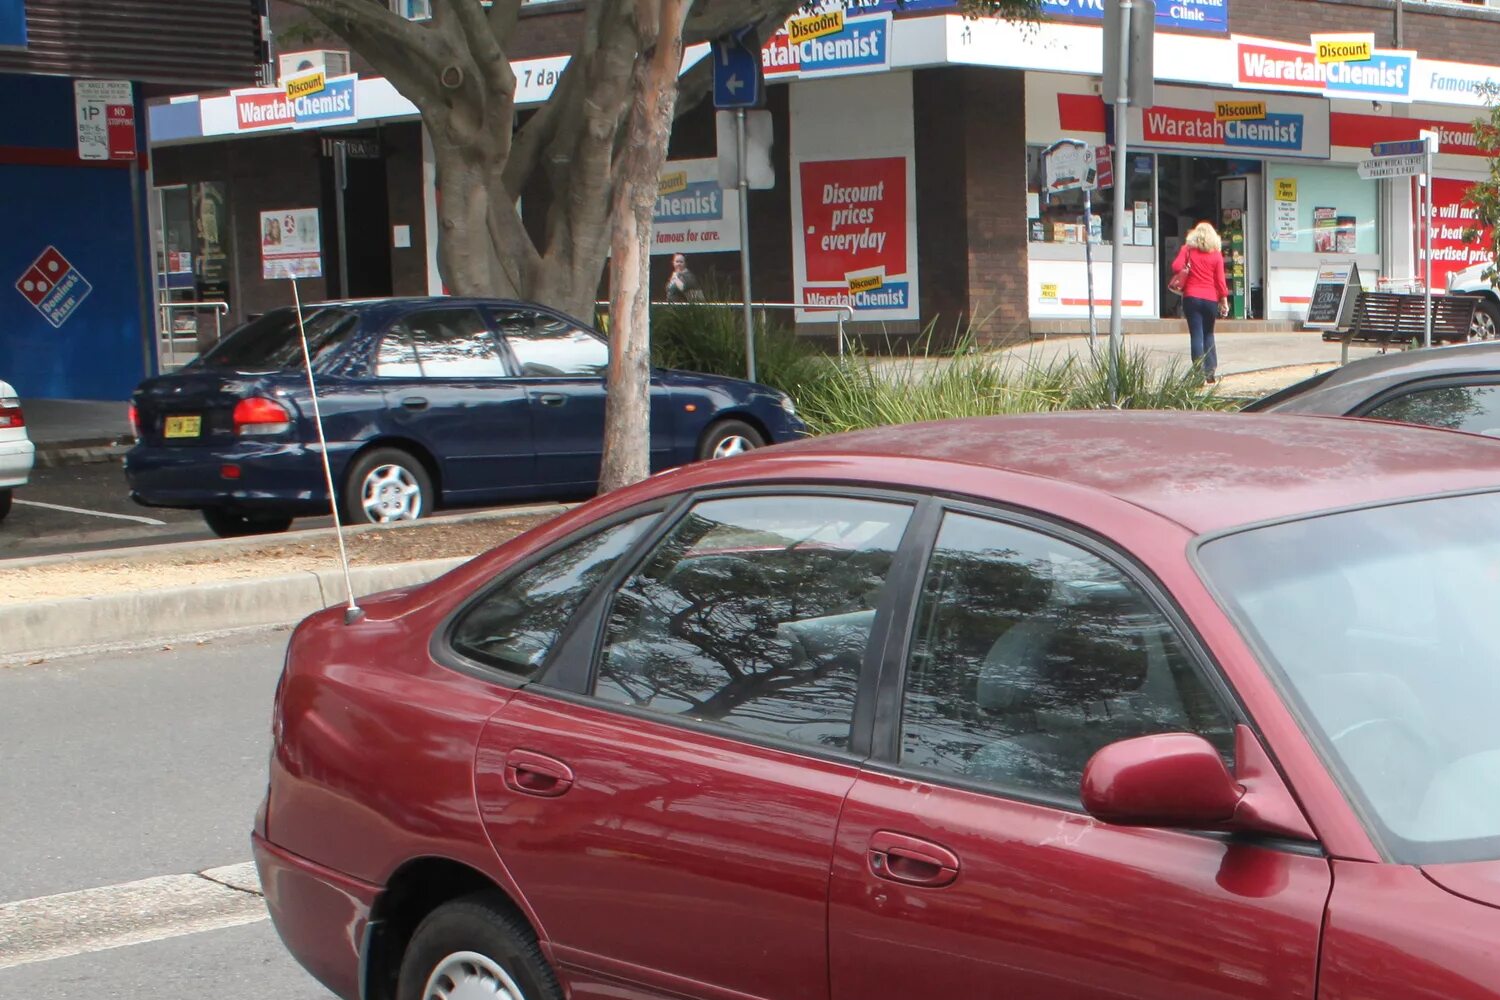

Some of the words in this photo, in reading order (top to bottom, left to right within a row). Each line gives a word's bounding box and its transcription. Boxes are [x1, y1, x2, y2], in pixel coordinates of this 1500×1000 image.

[1170, 6, 1205, 21] Clinic
[791, 16, 838, 38] Discount
[1320, 44, 1366, 58] Discount
[288, 76, 322, 95] Discount
[524, 71, 532, 87] 7
[1430, 72, 1481, 94] Famous
[114, 107, 126, 116] NO
[1218, 103, 1262, 117] Discount
[823, 181, 884, 204] Discount
[832, 204, 874, 230] prices
[1440, 204, 1459, 218] will
[656, 231, 685, 243] famous
[687, 229, 698, 241] for
[821, 228, 886, 255] everyday
[850, 276, 880, 289] Discount
[41, 275, 79, 313] Domino's
[50, 297, 75, 322] Pizza
